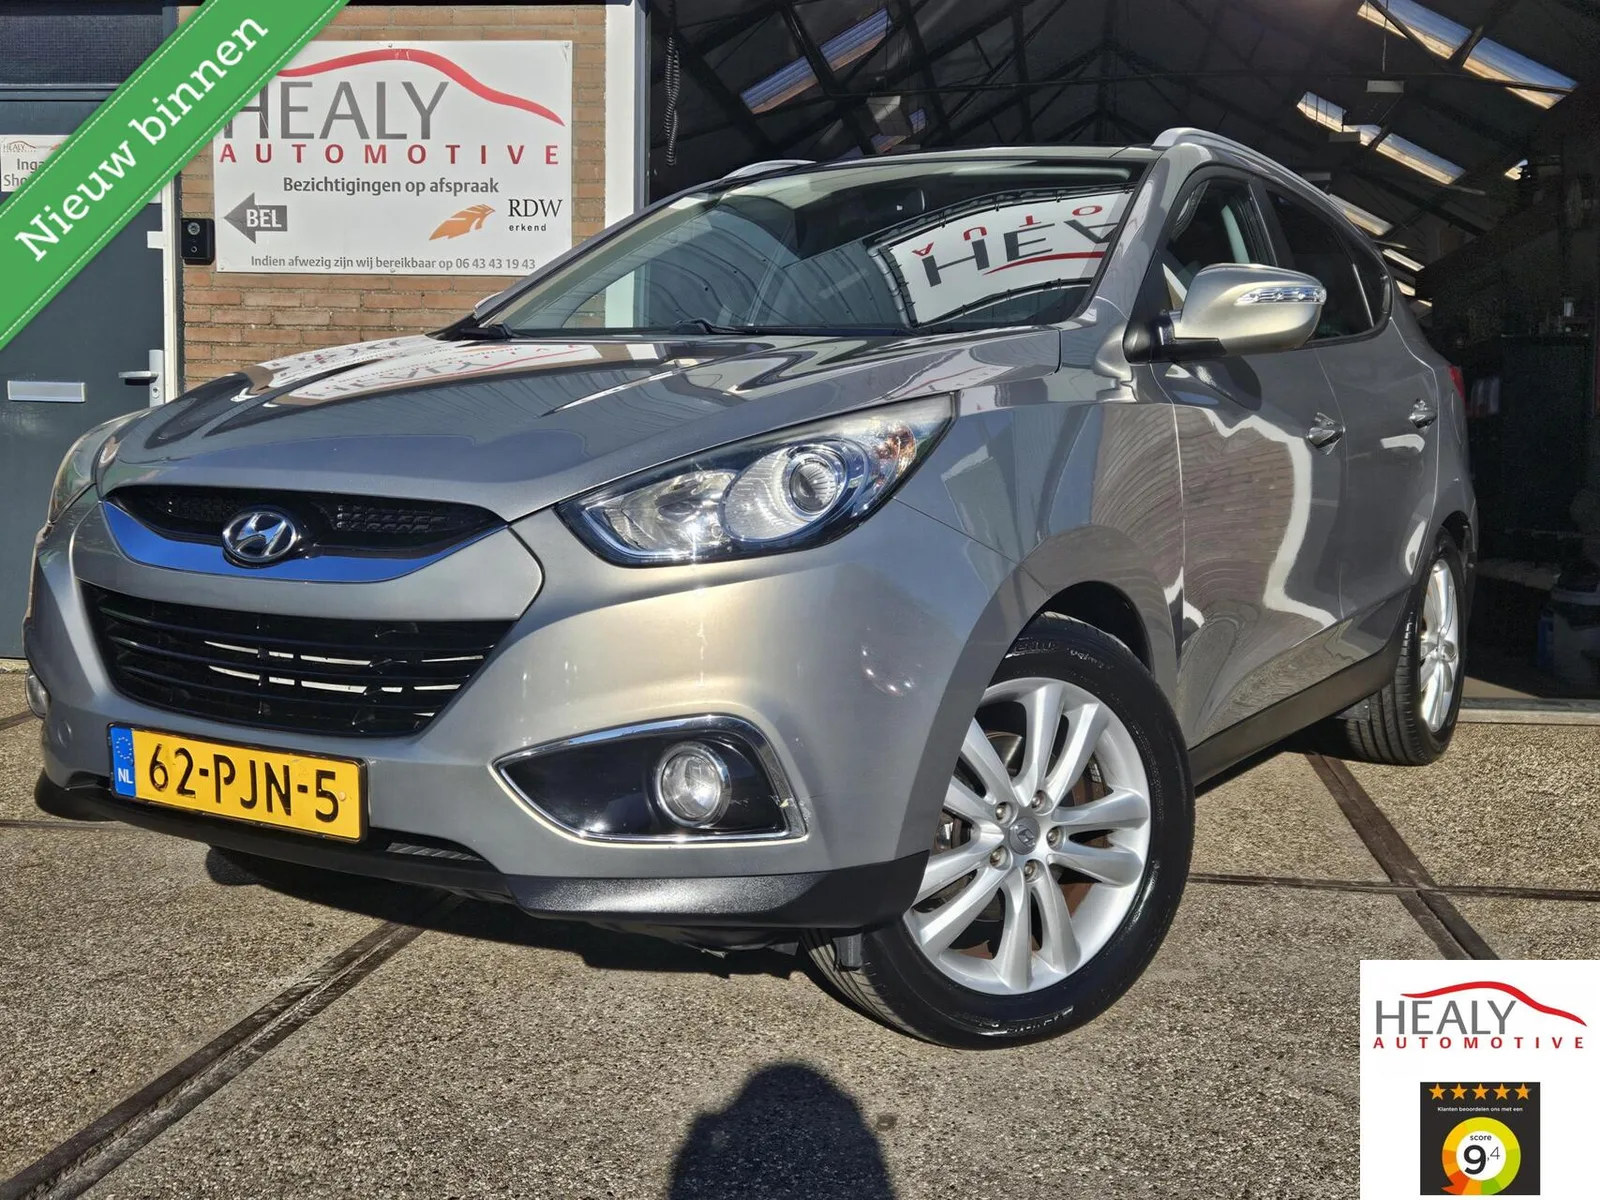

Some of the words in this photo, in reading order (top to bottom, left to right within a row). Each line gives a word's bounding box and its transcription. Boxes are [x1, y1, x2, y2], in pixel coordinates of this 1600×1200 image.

[219, 143, 558, 165] AUTOMOTIVE
[283, 176, 401, 196] Bezichtigingen
[405, 180, 426, 197] op
[429, 177, 500, 197] afspraak
[508, 198, 563, 218] RDW
[246, 209, 282, 228] BEL
[508, 224, 547, 232] erkend
[251, 255, 286, 267] Indien
[289, 256, 332, 269] afwezig
[334, 257, 354, 269] zijn
[356, 257, 374, 270] wij
[376, 257, 437, 269] bereikbaar
[438, 260, 453, 270] op
[455, 258, 470, 269] 06
[472, 258, 486, 269] 43
[487, 258, 503, 269] 43
[506, 258, 520, 270] 19
[521, 258, 536, 270] 43
[118, 767, 133, 784] NL
[149, 743, 339, 823] 62-PJN-5
